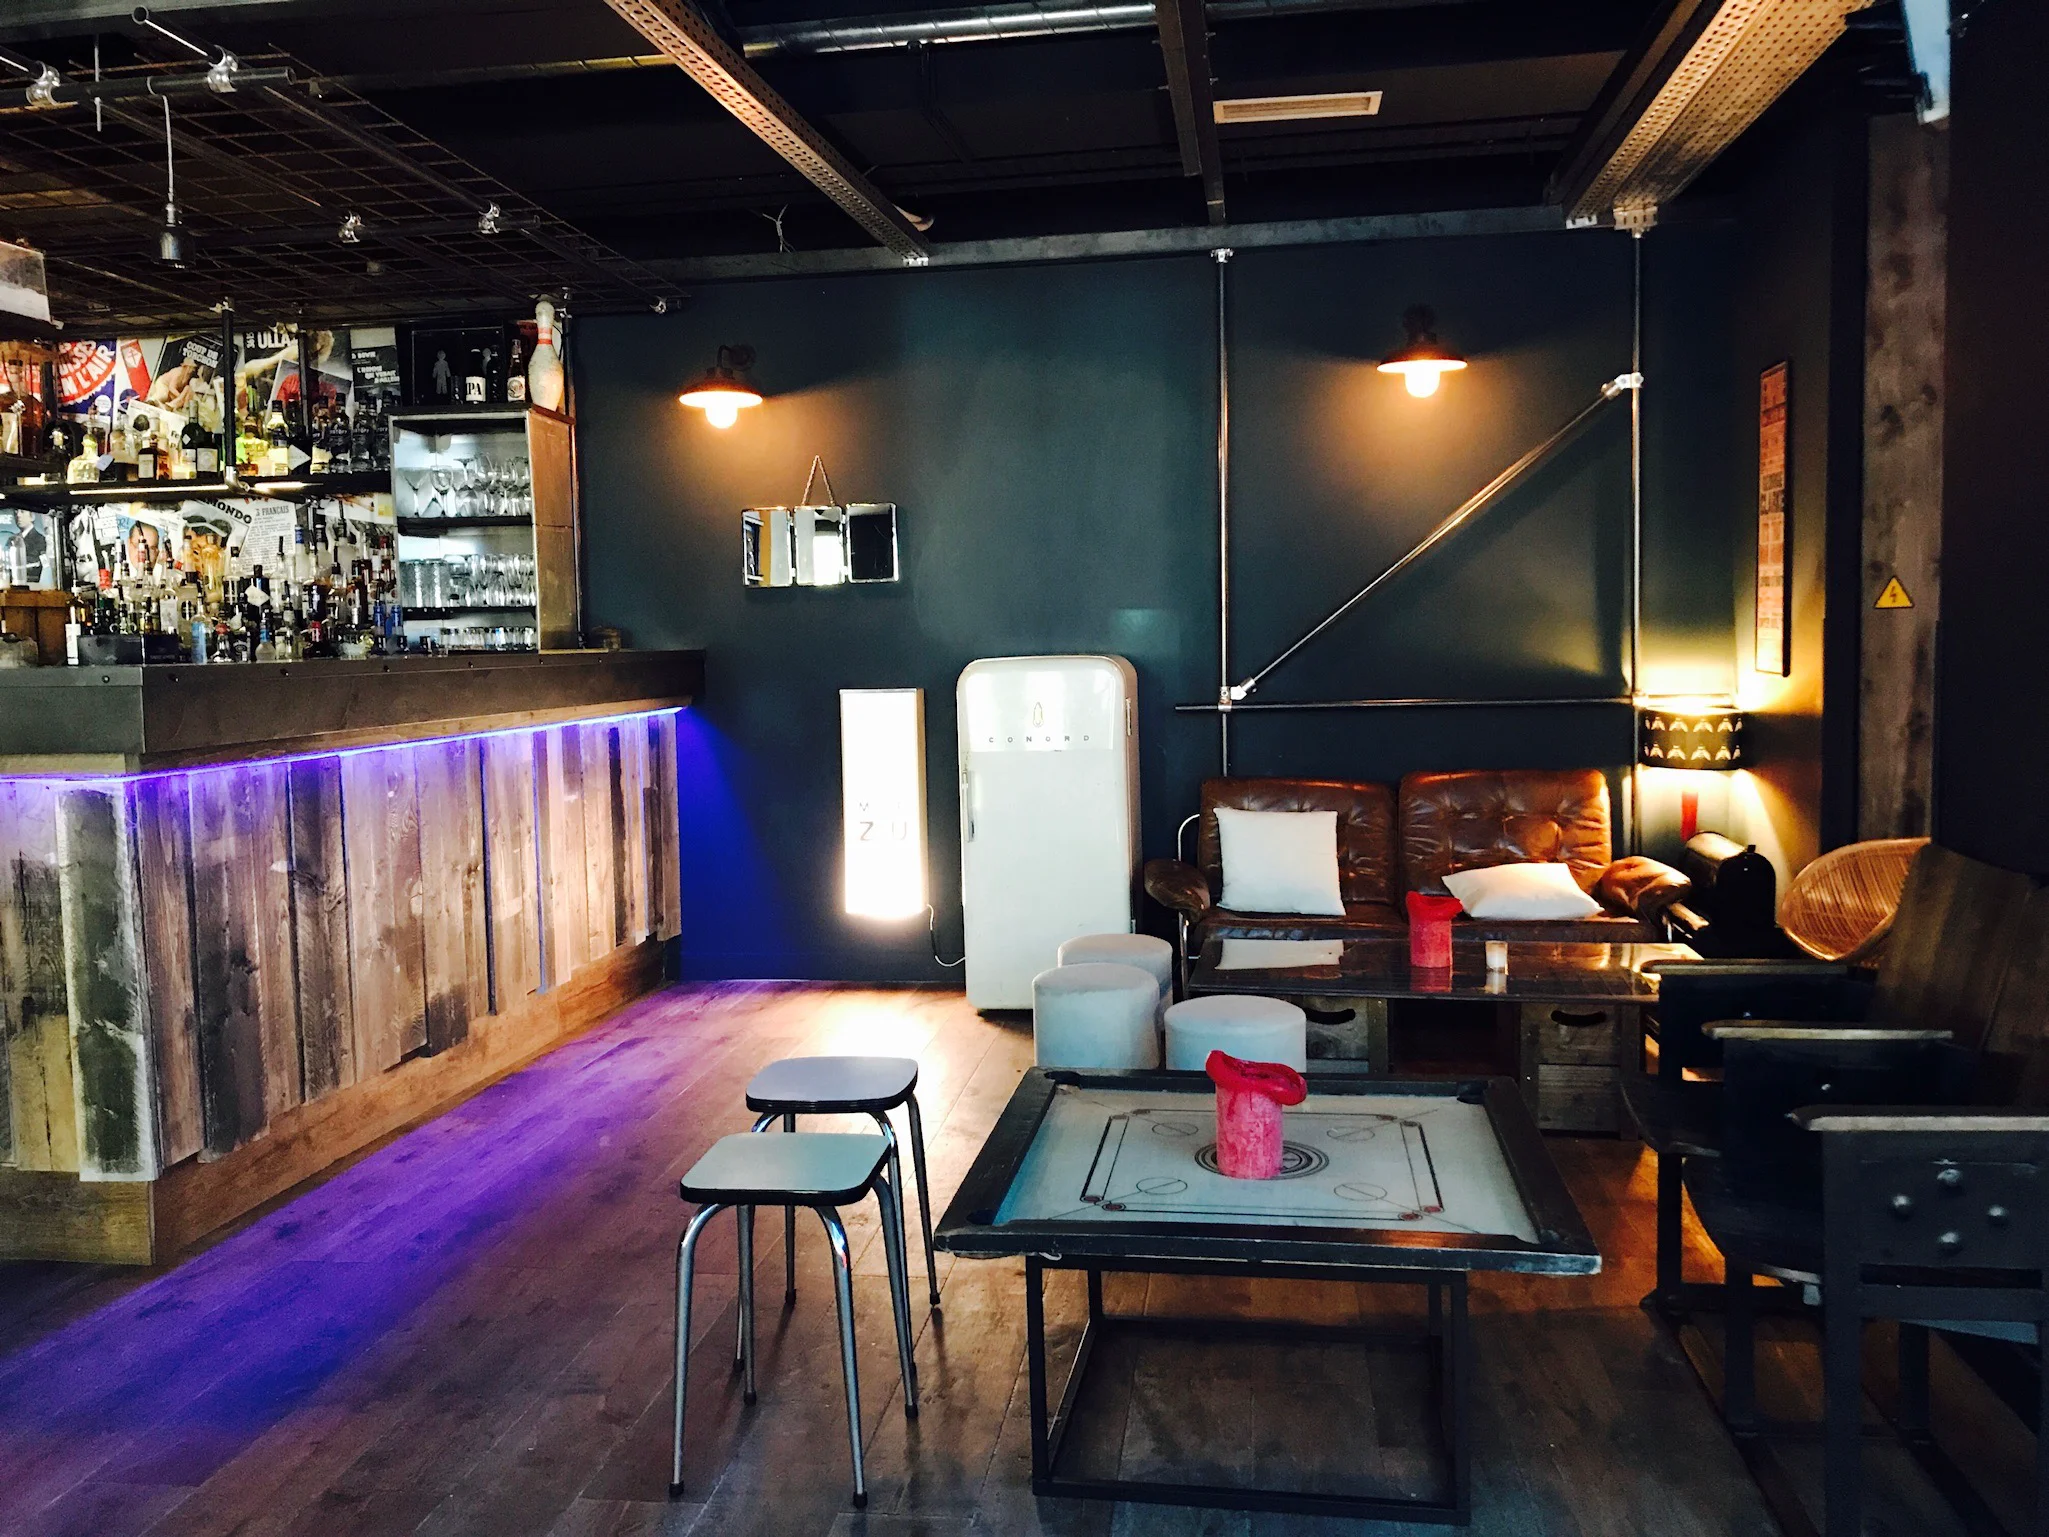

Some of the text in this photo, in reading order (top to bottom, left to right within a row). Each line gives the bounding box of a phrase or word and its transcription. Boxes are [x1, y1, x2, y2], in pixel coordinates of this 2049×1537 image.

[182, 347, 218, 368] TORCHON
[186, 341, 207, 355] COUP
[207, 349, 218, 359] DE
[988, 734, 1090, 744] CONORD
